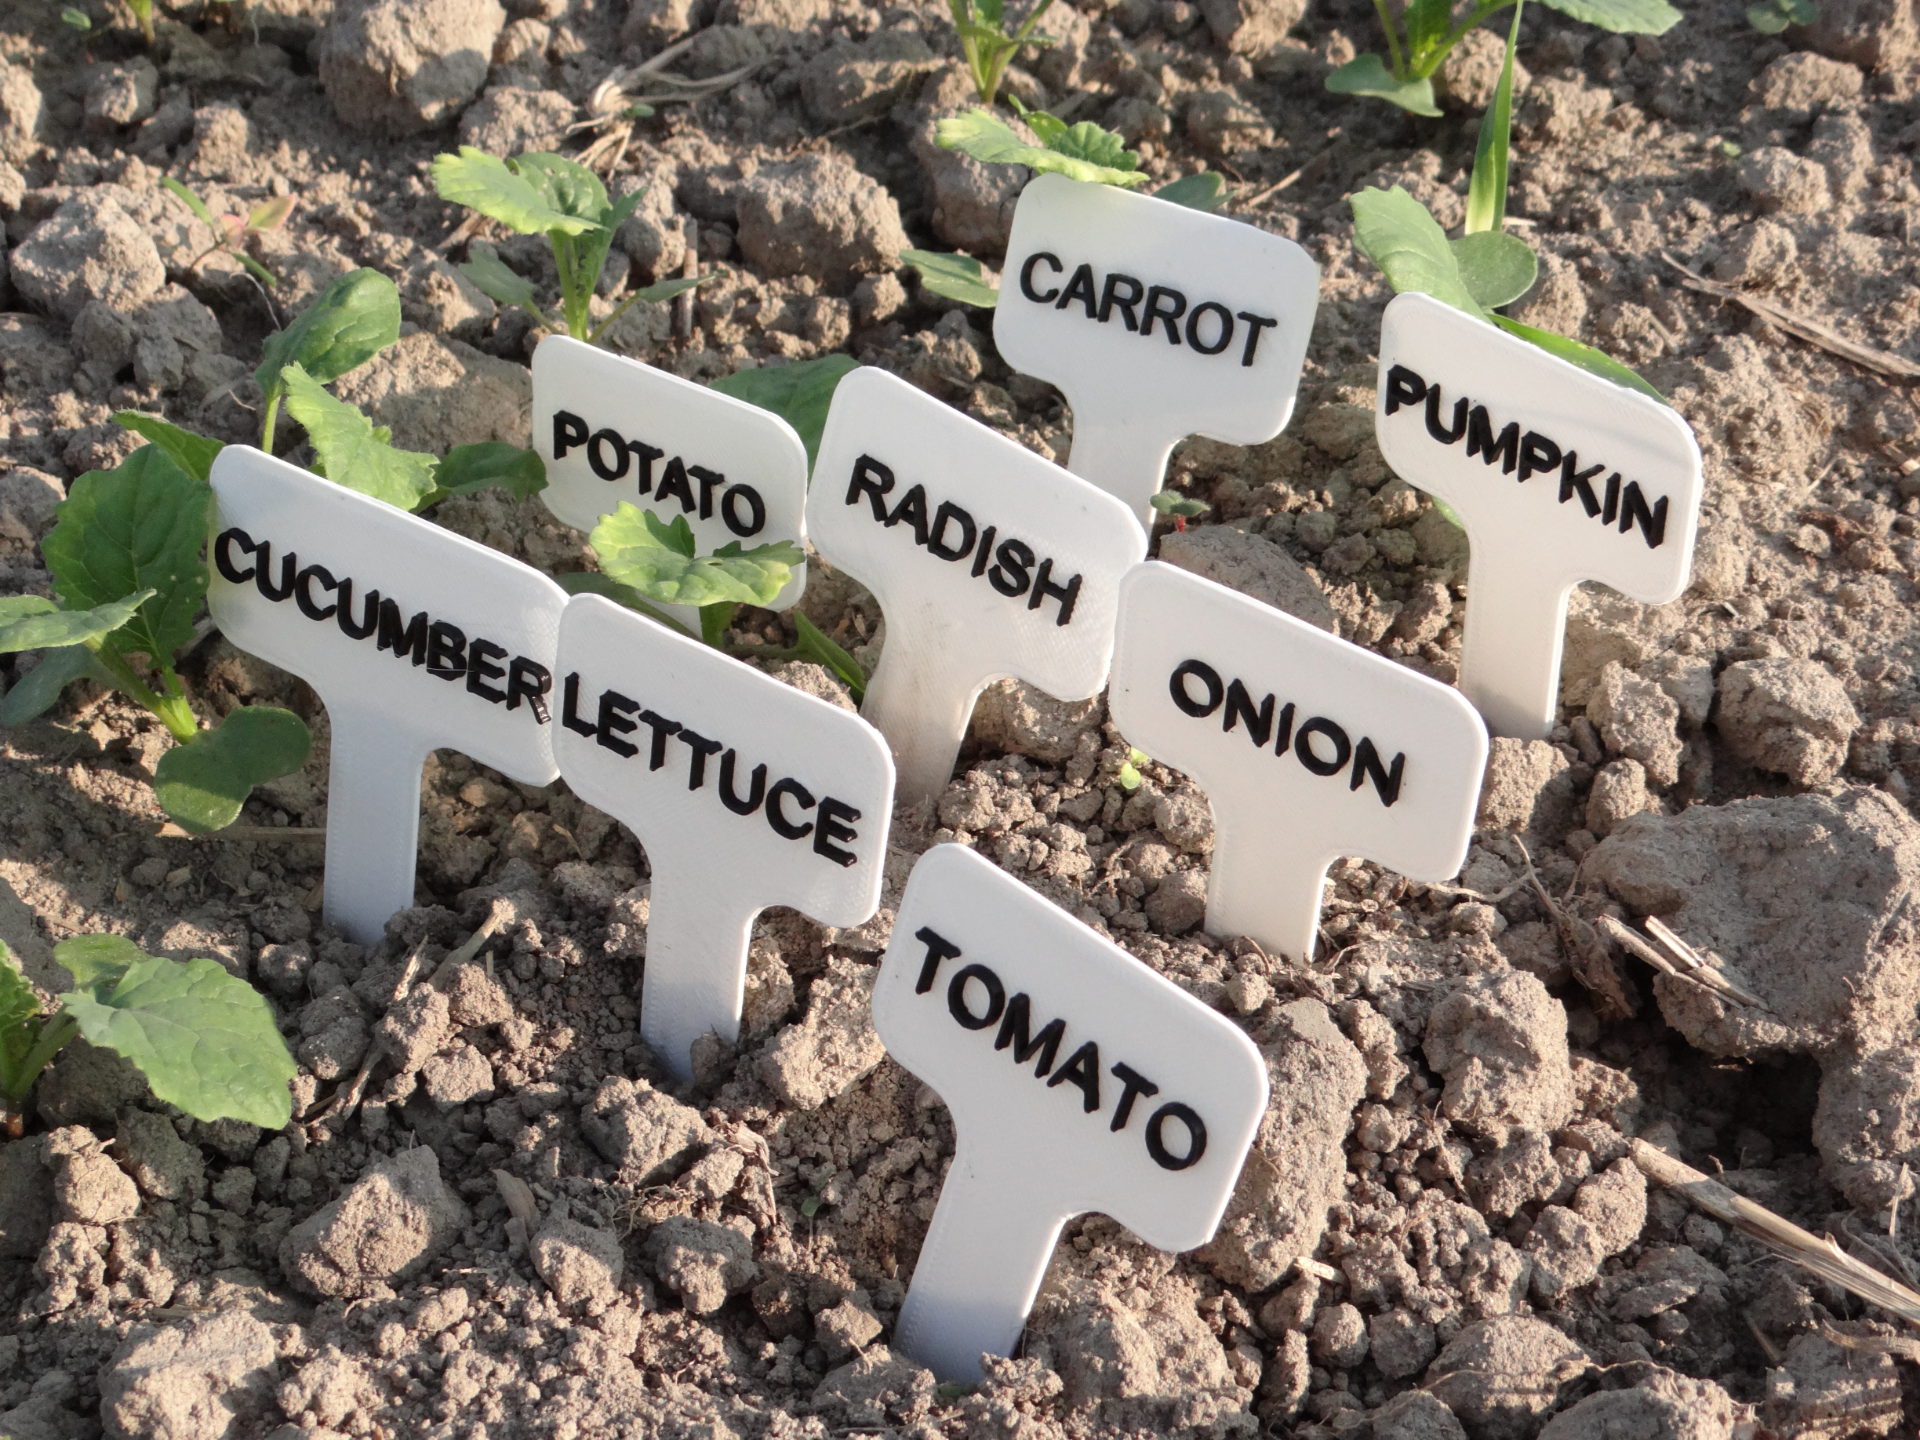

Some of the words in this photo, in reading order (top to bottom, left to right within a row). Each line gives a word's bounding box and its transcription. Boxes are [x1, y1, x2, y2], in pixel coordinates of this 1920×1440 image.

[1020, 251, 1278, 367] CARROT
[553, 410, 767, 538] POTATO
[846, 453, 1083, 627] RADISH
[1386, 365, 1669, 549] PUMPKIN
[214, 527, 553, 725] CUCUMBER
[562, 671, 862, 868] LETTUCE
[1169, 659, 1406, 808] ONION
[915, 926, 1208, 1172] TOMATO
